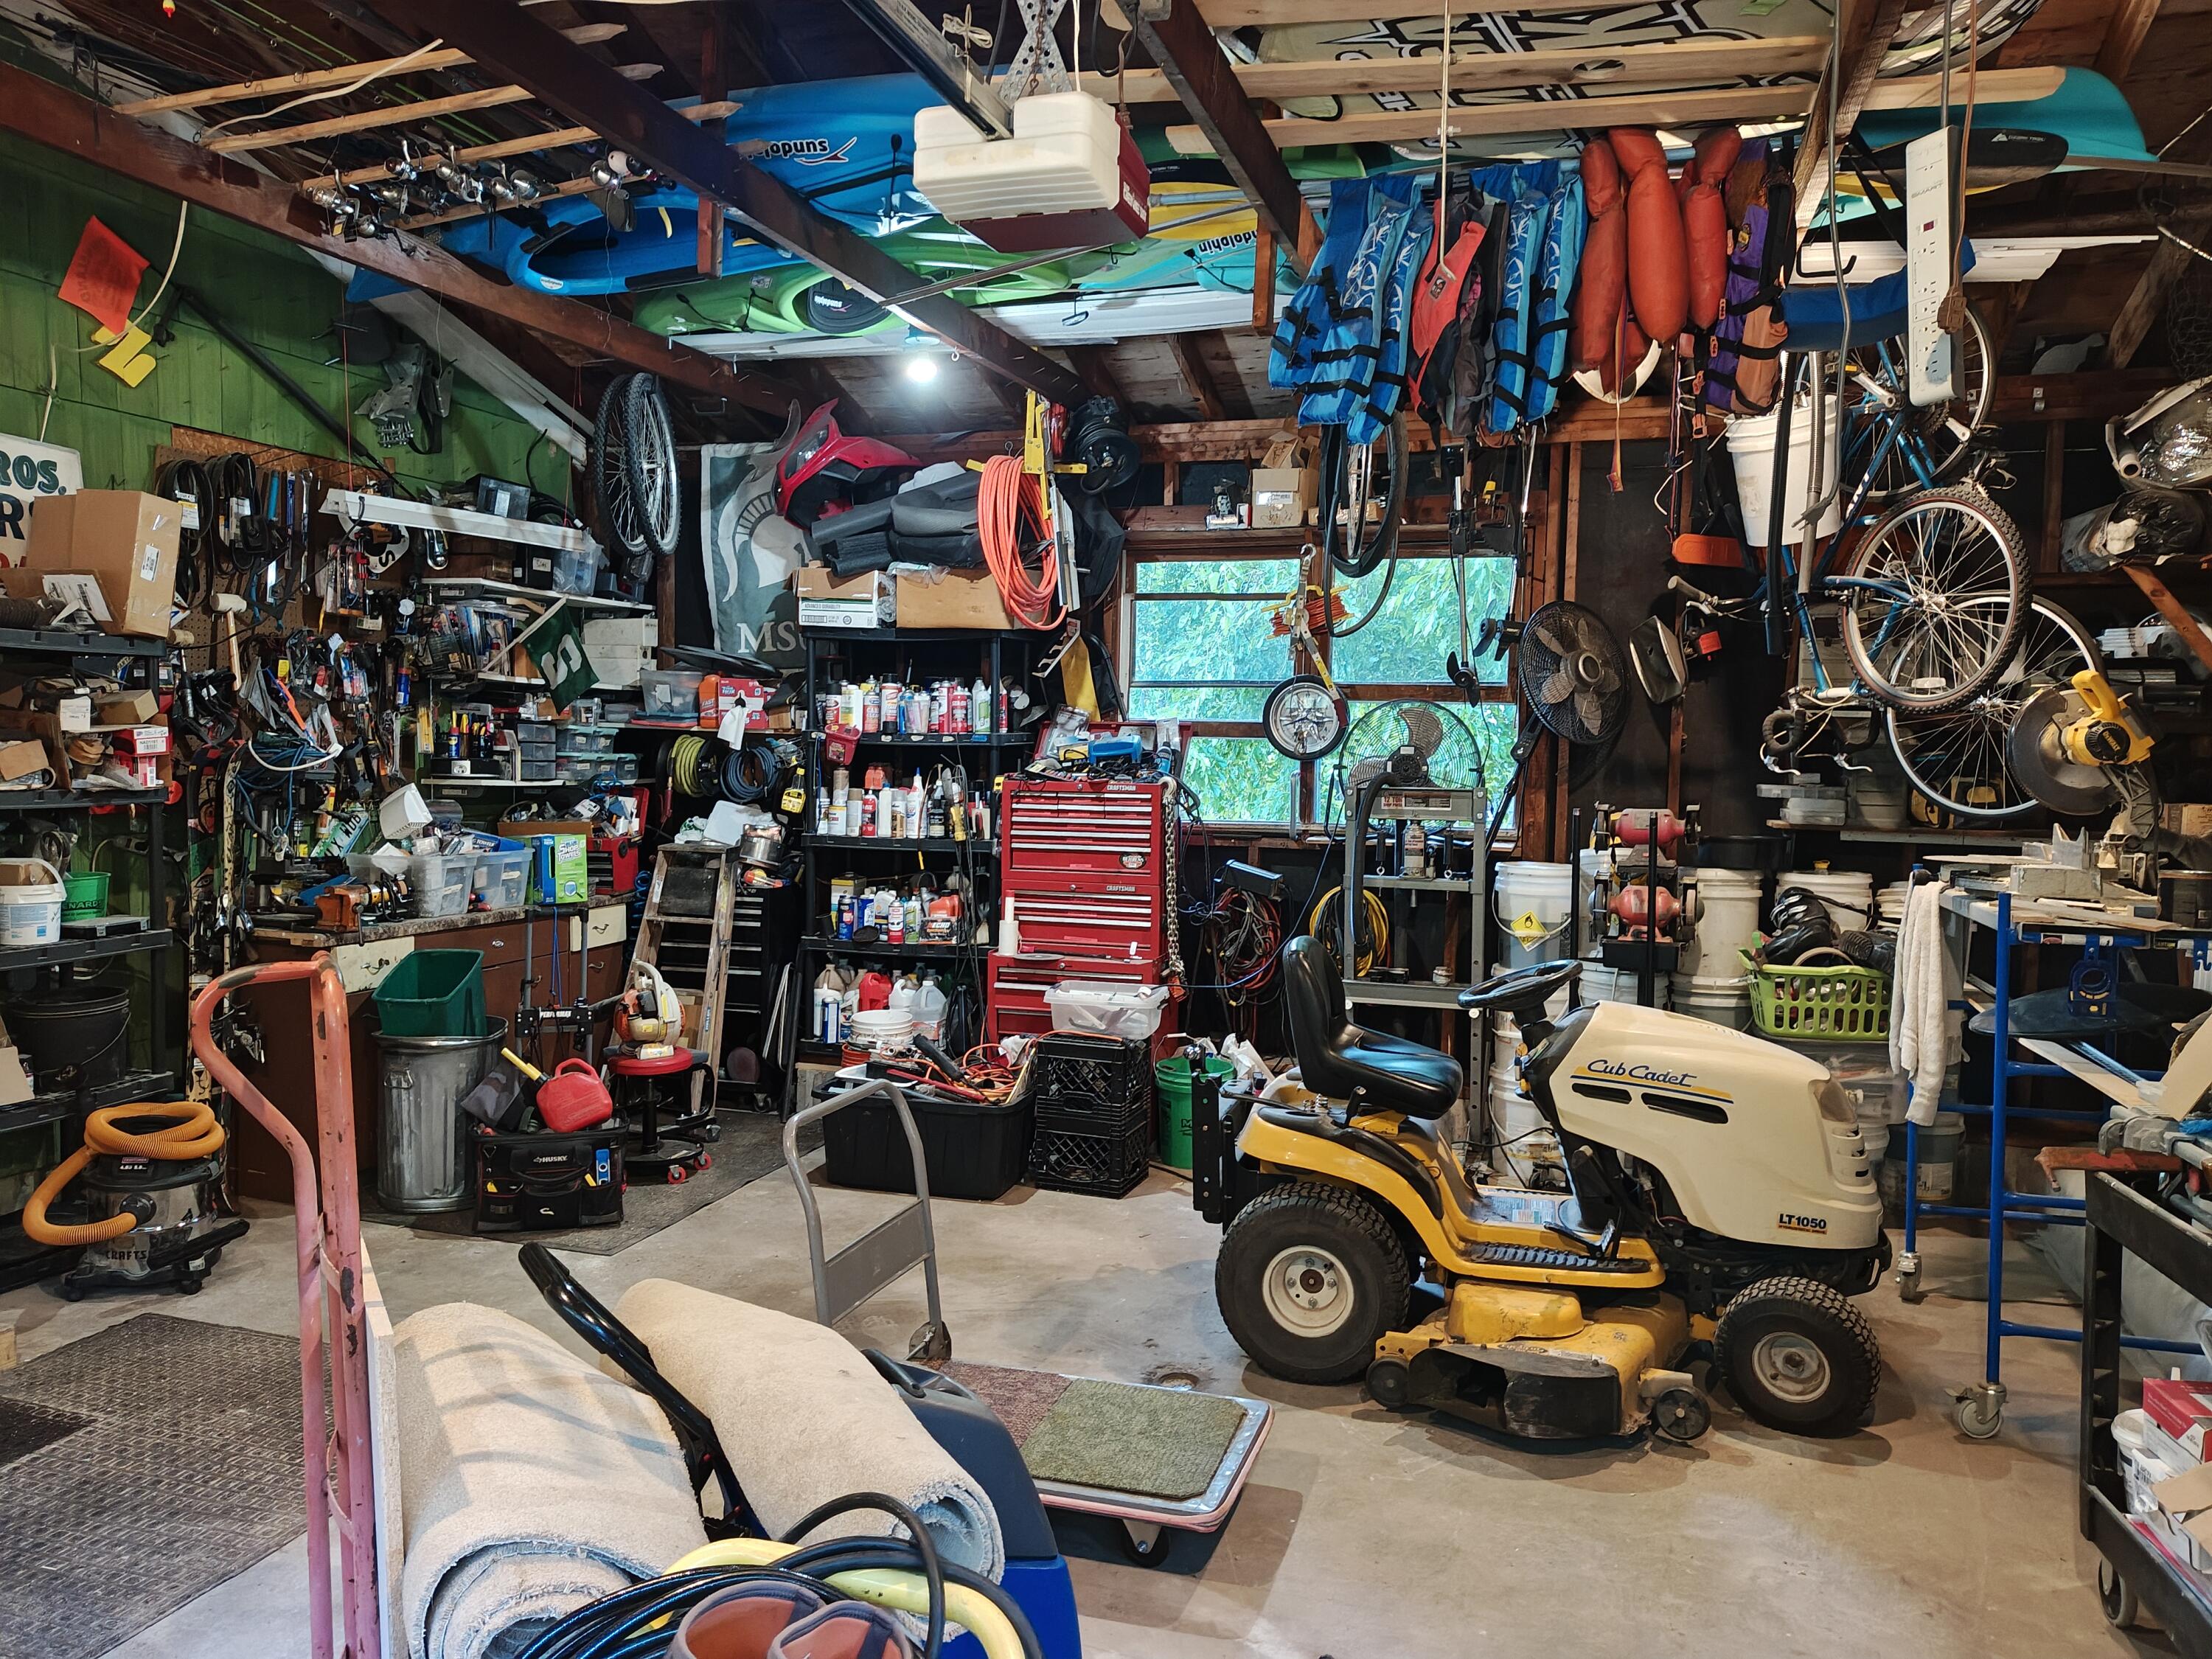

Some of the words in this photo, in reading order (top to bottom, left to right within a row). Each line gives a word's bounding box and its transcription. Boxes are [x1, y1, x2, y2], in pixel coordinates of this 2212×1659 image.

[737, 139, 829, 161] sundol
[540, 634, 582, 690] S
[702, 699, 715, 709] FAST
[557, 850, 580, 862] TOWELS
[559, 844, 579, 854] SHOP
[1587, 1059, 1627, 1077] Cub
[1628, 1065, 1697, 1088] Cadet
[542, 1155, 568, 1163] HUSKY
[1778, 1213, 1827, 1229] LT1050
